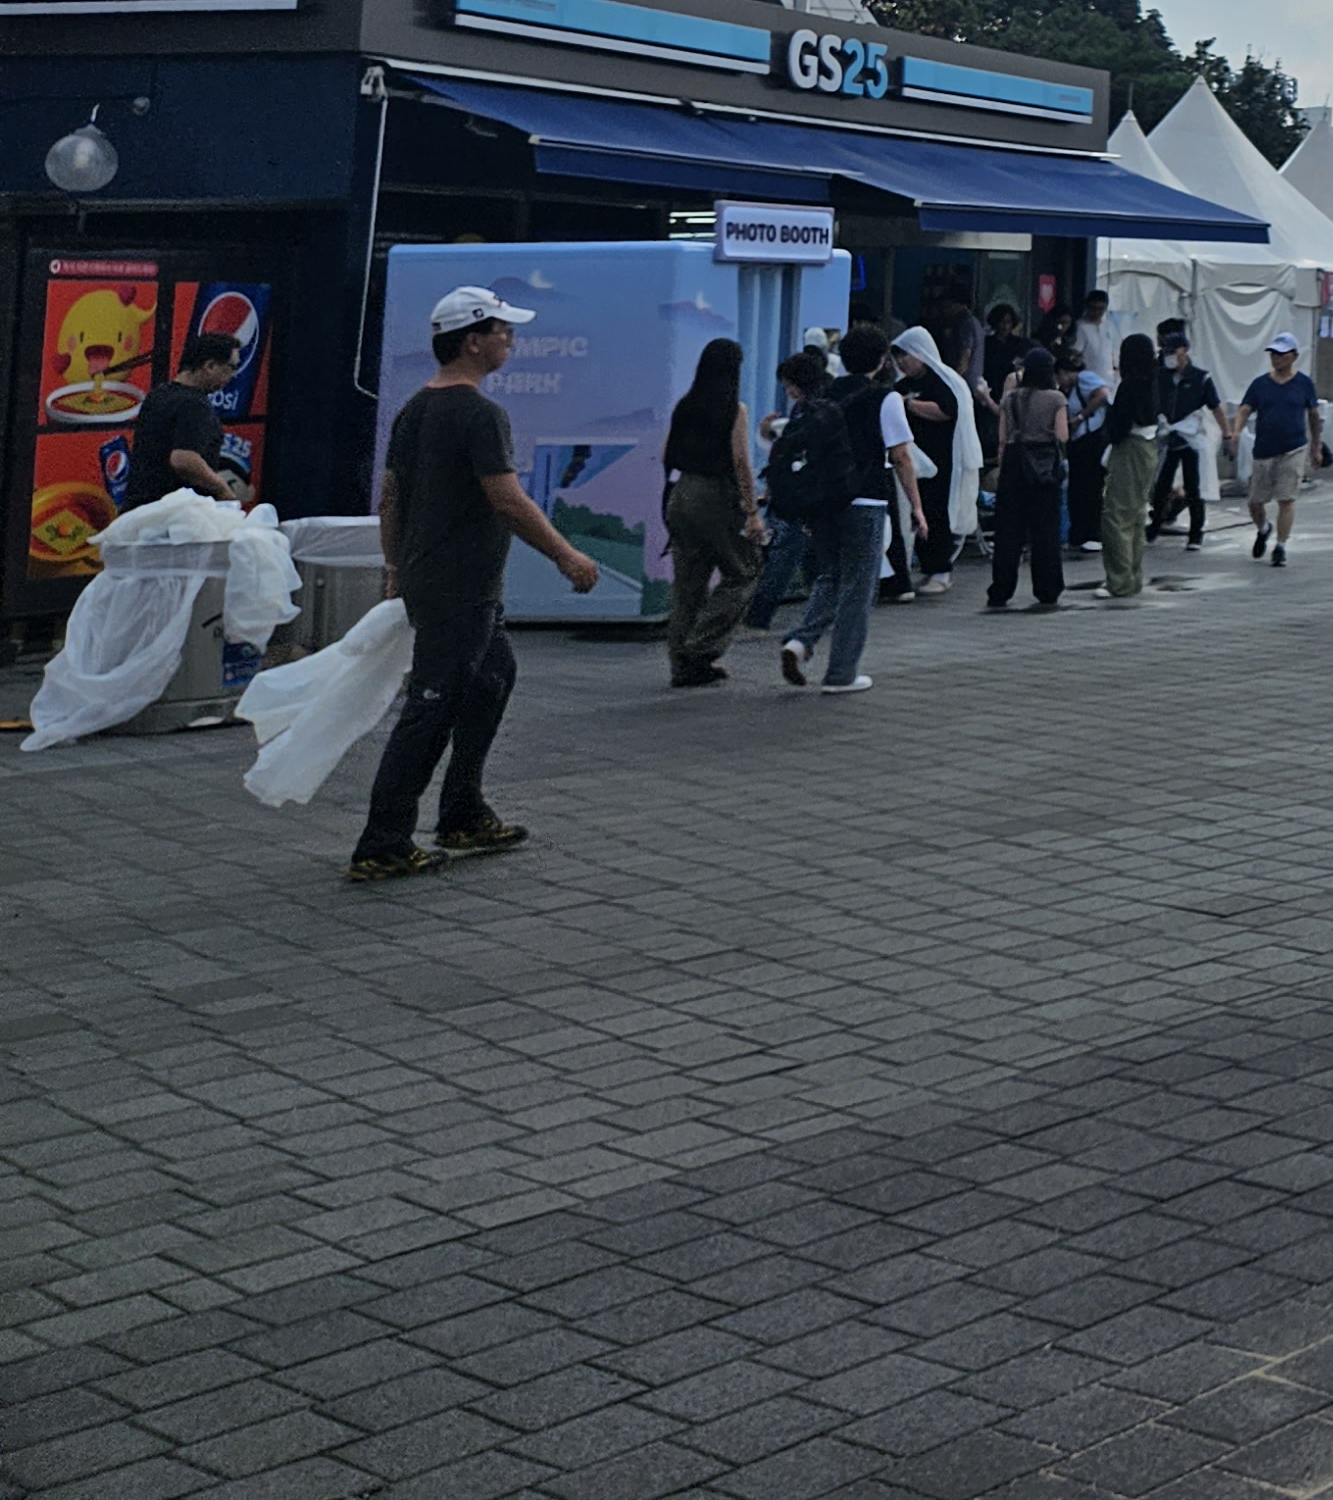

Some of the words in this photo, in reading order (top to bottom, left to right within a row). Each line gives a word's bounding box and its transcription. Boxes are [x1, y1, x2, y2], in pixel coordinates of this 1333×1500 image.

[789, 29, 889, 100] GS25
[726, 222, 777, 243] PHOTO
[780, 225, 829, 245] BOOTH
